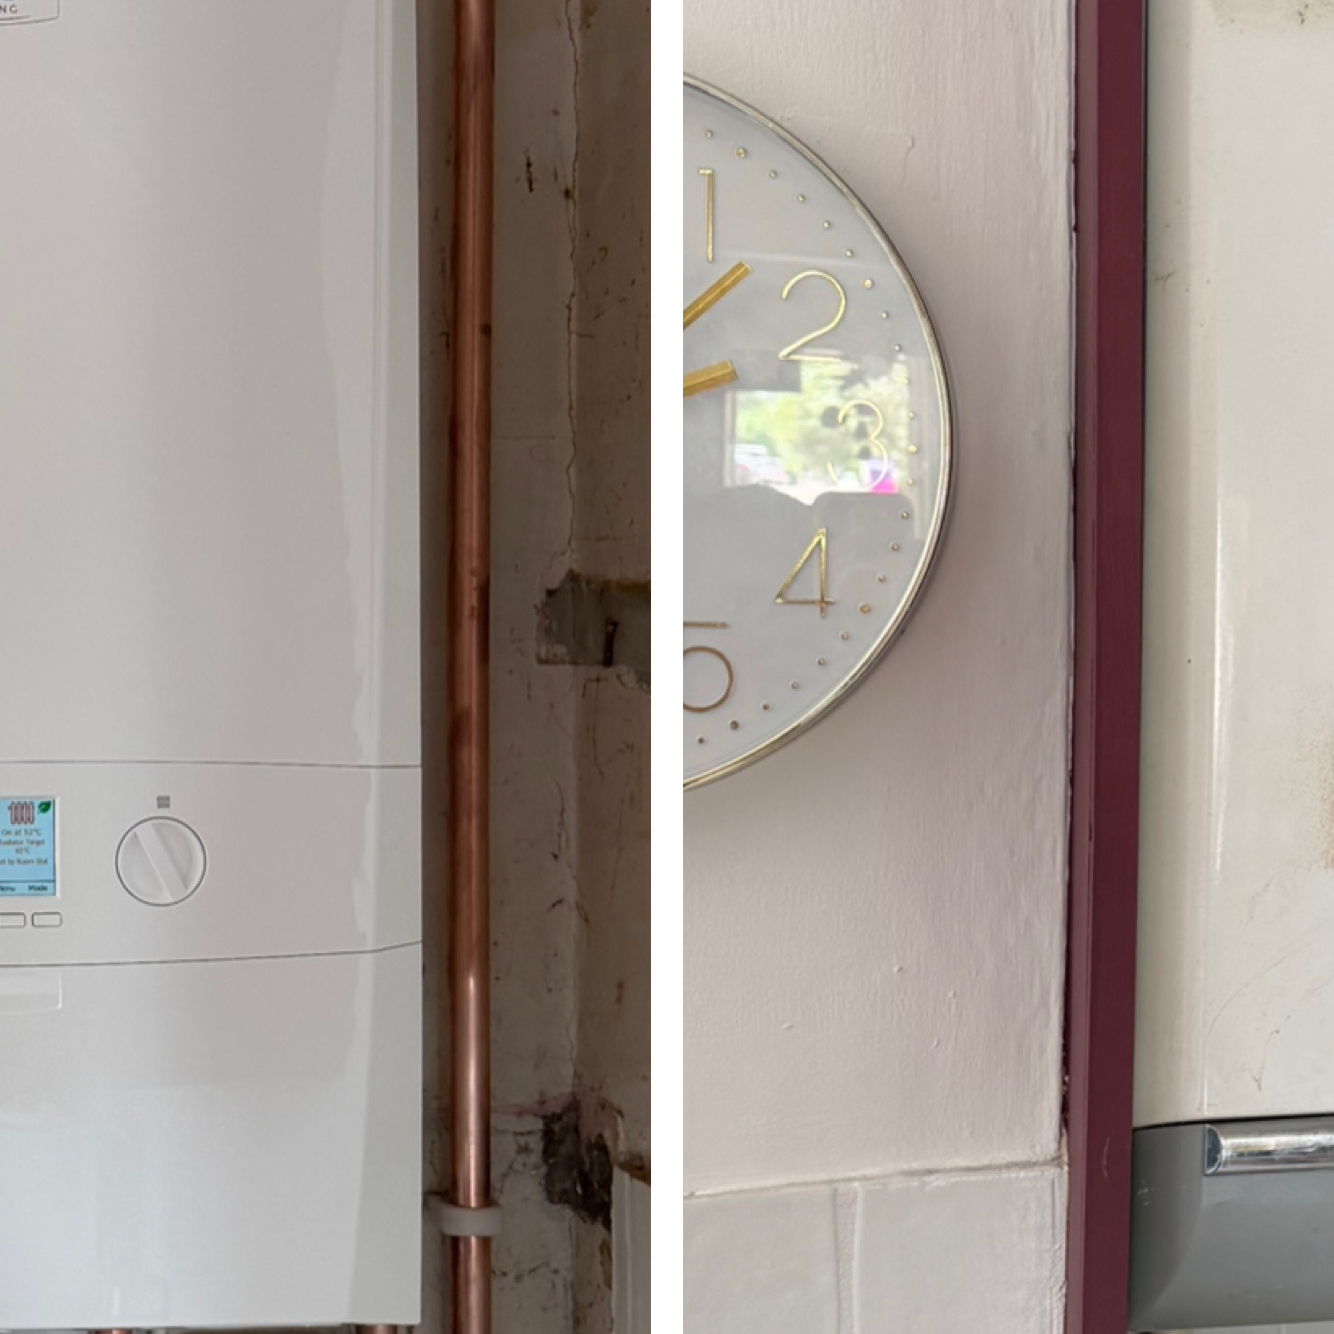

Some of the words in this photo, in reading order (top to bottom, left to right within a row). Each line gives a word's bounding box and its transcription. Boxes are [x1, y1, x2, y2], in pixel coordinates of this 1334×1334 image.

[697, 168, 715, 262] 1
[778, 269, 848, 362] 2
[828, 400, 890, 494] 3
[774, 527, 835, 618] 4
